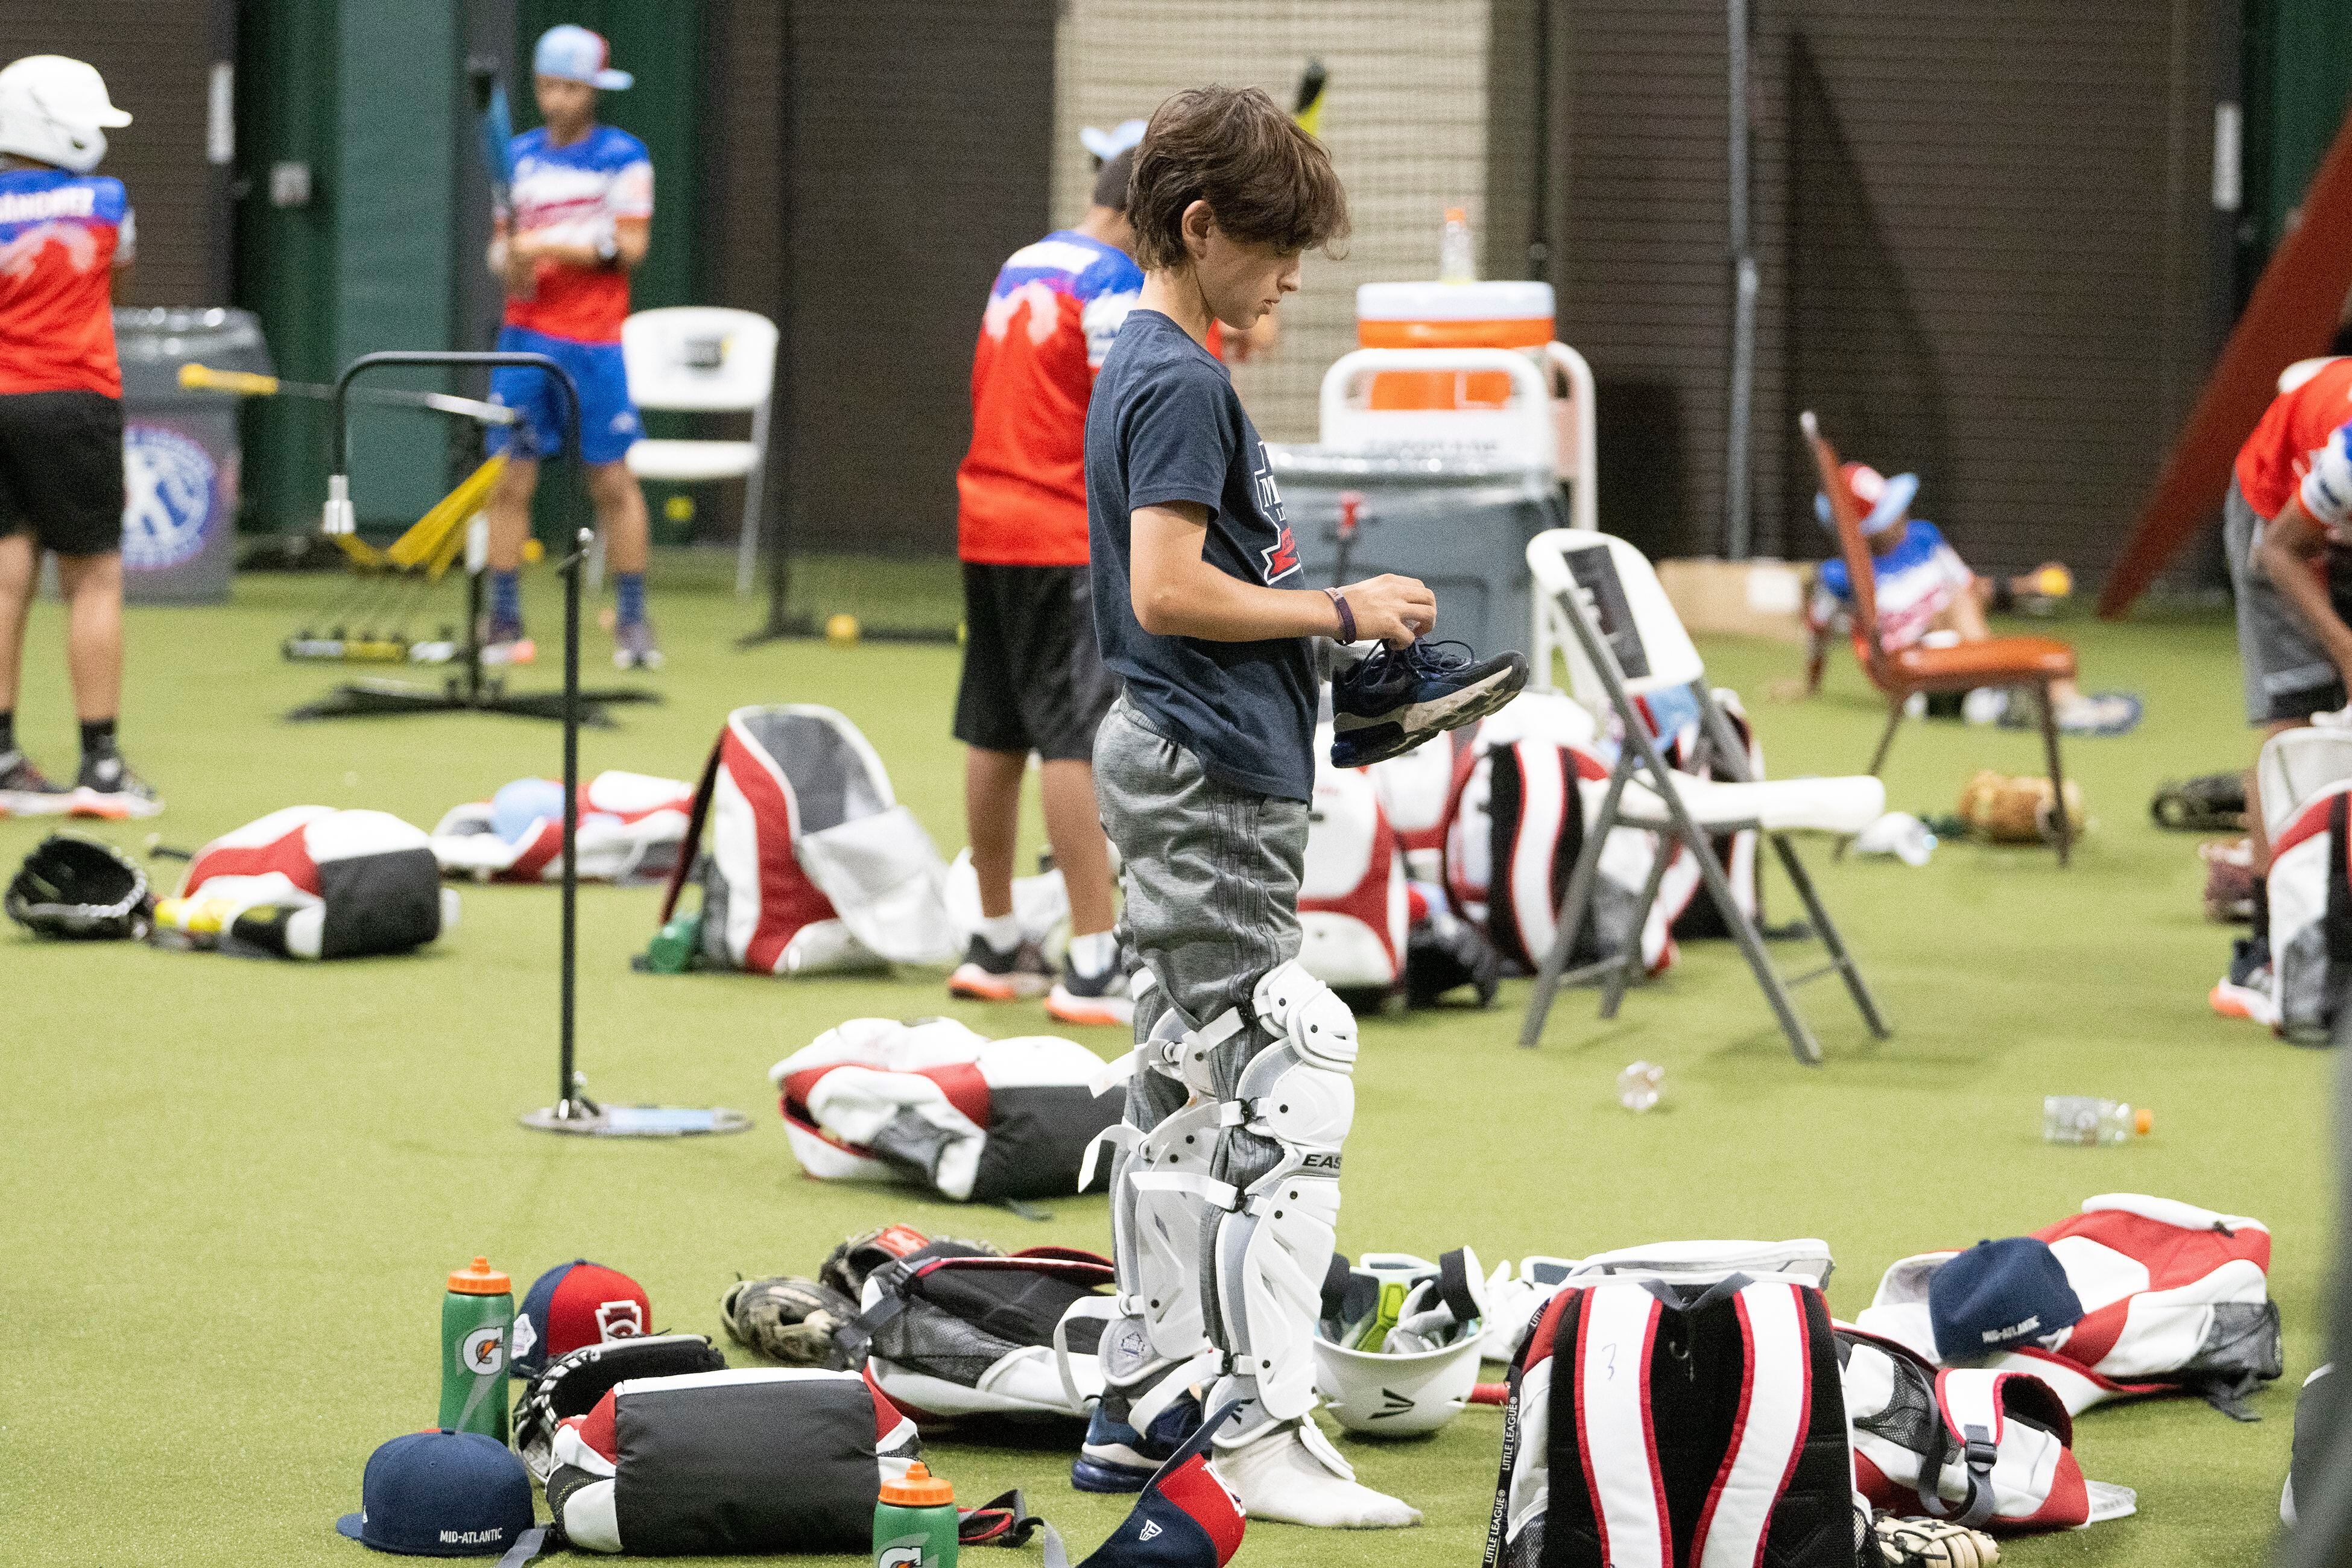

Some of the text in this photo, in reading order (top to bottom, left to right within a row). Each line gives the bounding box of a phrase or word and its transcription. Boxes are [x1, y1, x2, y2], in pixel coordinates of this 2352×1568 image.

[1502, 1444, 1513, 1471] LITTLE
[440, 1527, 503, 1544] MID-ATLANTIC
[1484, 1536, 1496, 1564] LITTLE
